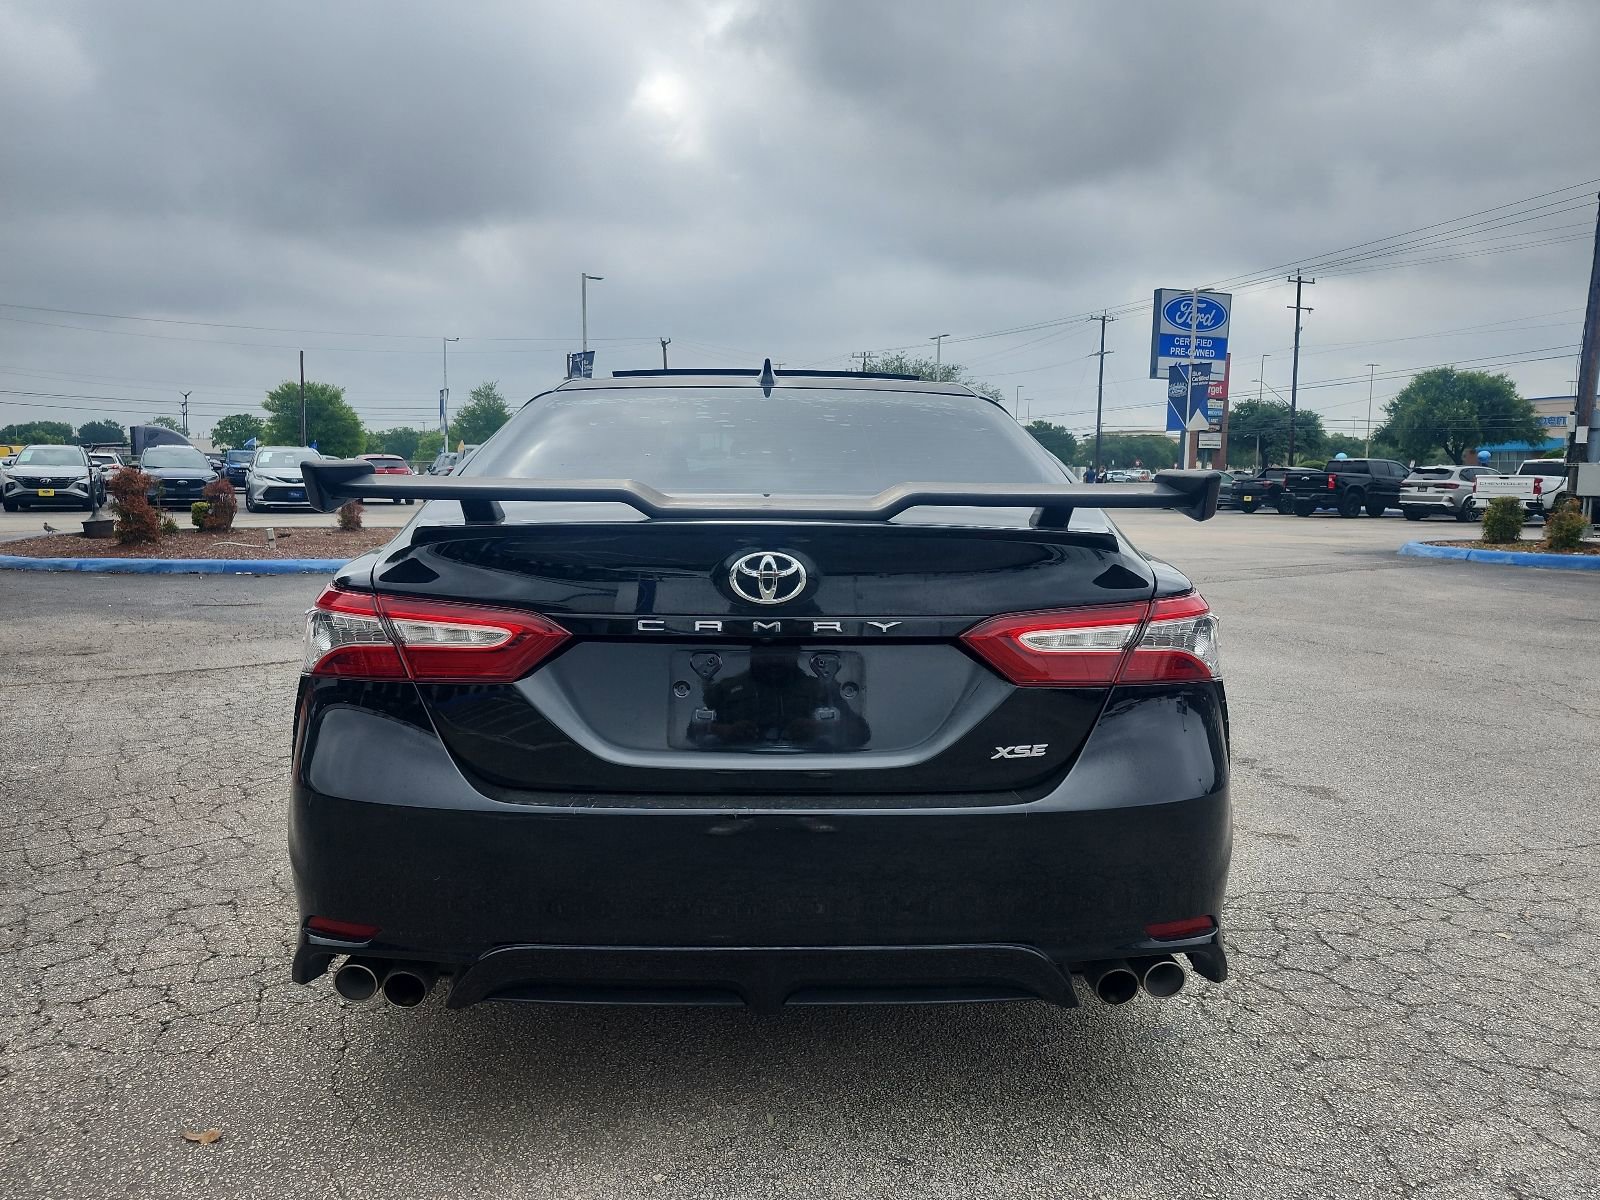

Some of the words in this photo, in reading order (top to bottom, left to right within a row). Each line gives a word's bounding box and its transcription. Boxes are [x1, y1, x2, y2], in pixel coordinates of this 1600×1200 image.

[1176, 301, 1216, 327] Ford
[1174, 337, 1213, 347] CERFIED
[1207, 385, 1223, 396] rget
[637, 620, 902, 633] CAMRY
[990, 743, 1049, 760] XSE
